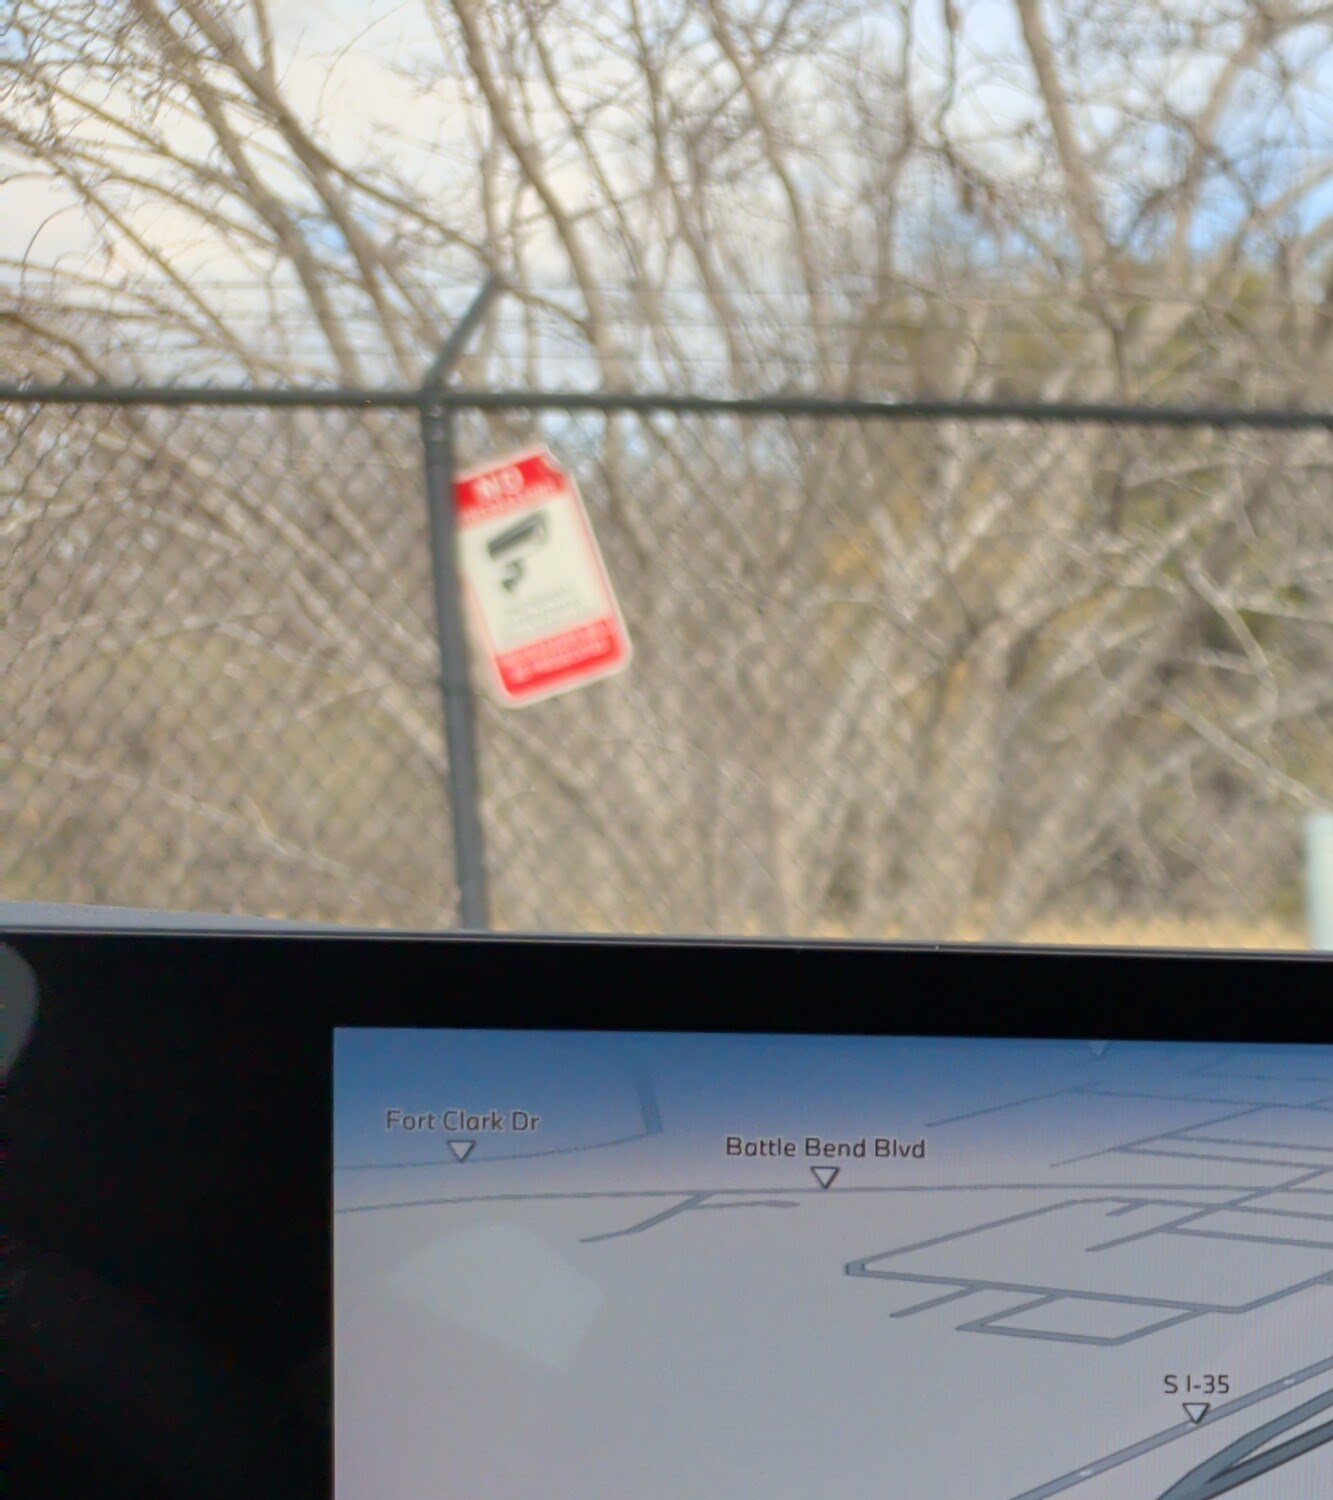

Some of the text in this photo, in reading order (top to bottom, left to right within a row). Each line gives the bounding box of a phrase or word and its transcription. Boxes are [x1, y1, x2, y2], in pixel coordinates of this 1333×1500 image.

[386, 1110, 540, 1133] Fort Clark Dr
[726, 1136, 926, 1160] Battle Bend Blvd
[1164, 1375, 1230, 1395] S I-35
